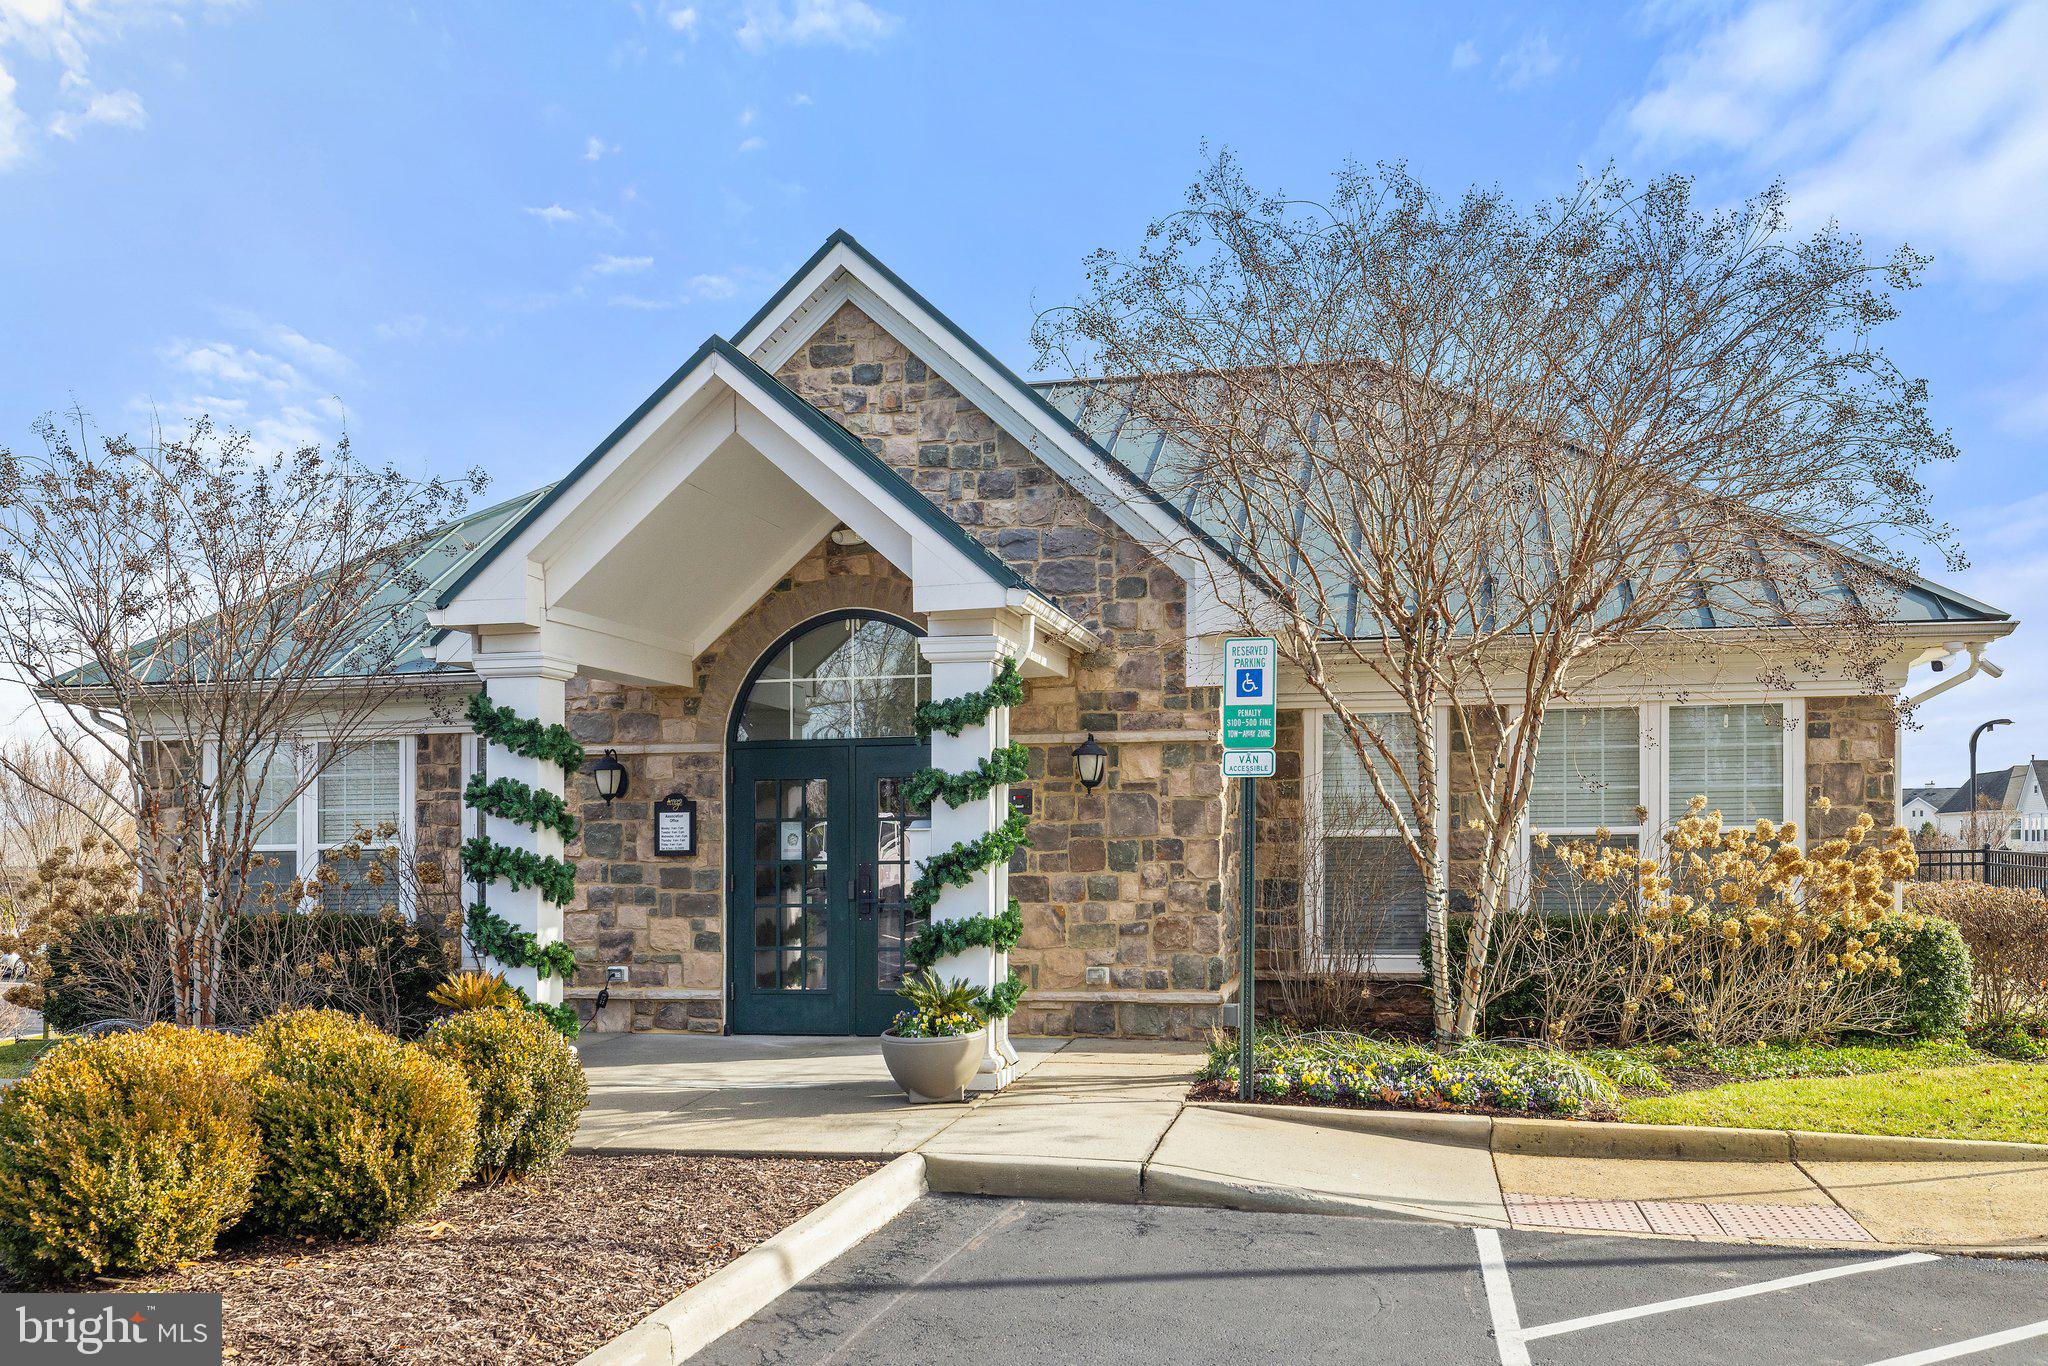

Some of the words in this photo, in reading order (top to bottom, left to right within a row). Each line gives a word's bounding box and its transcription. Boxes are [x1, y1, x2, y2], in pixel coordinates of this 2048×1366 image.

[1232, 646, 1268, 656] RESERVED
[1234, 658, 1266, 668] PARKING
[1237, 709, 1262, 717] PENALTY
[1227, 718, 1257, 727] $100-500
[1260, 718, 1272, 727] FINE
[1257, 730, 1271, 738] ZONE
[1239, 755, 1259, 764] VAN
